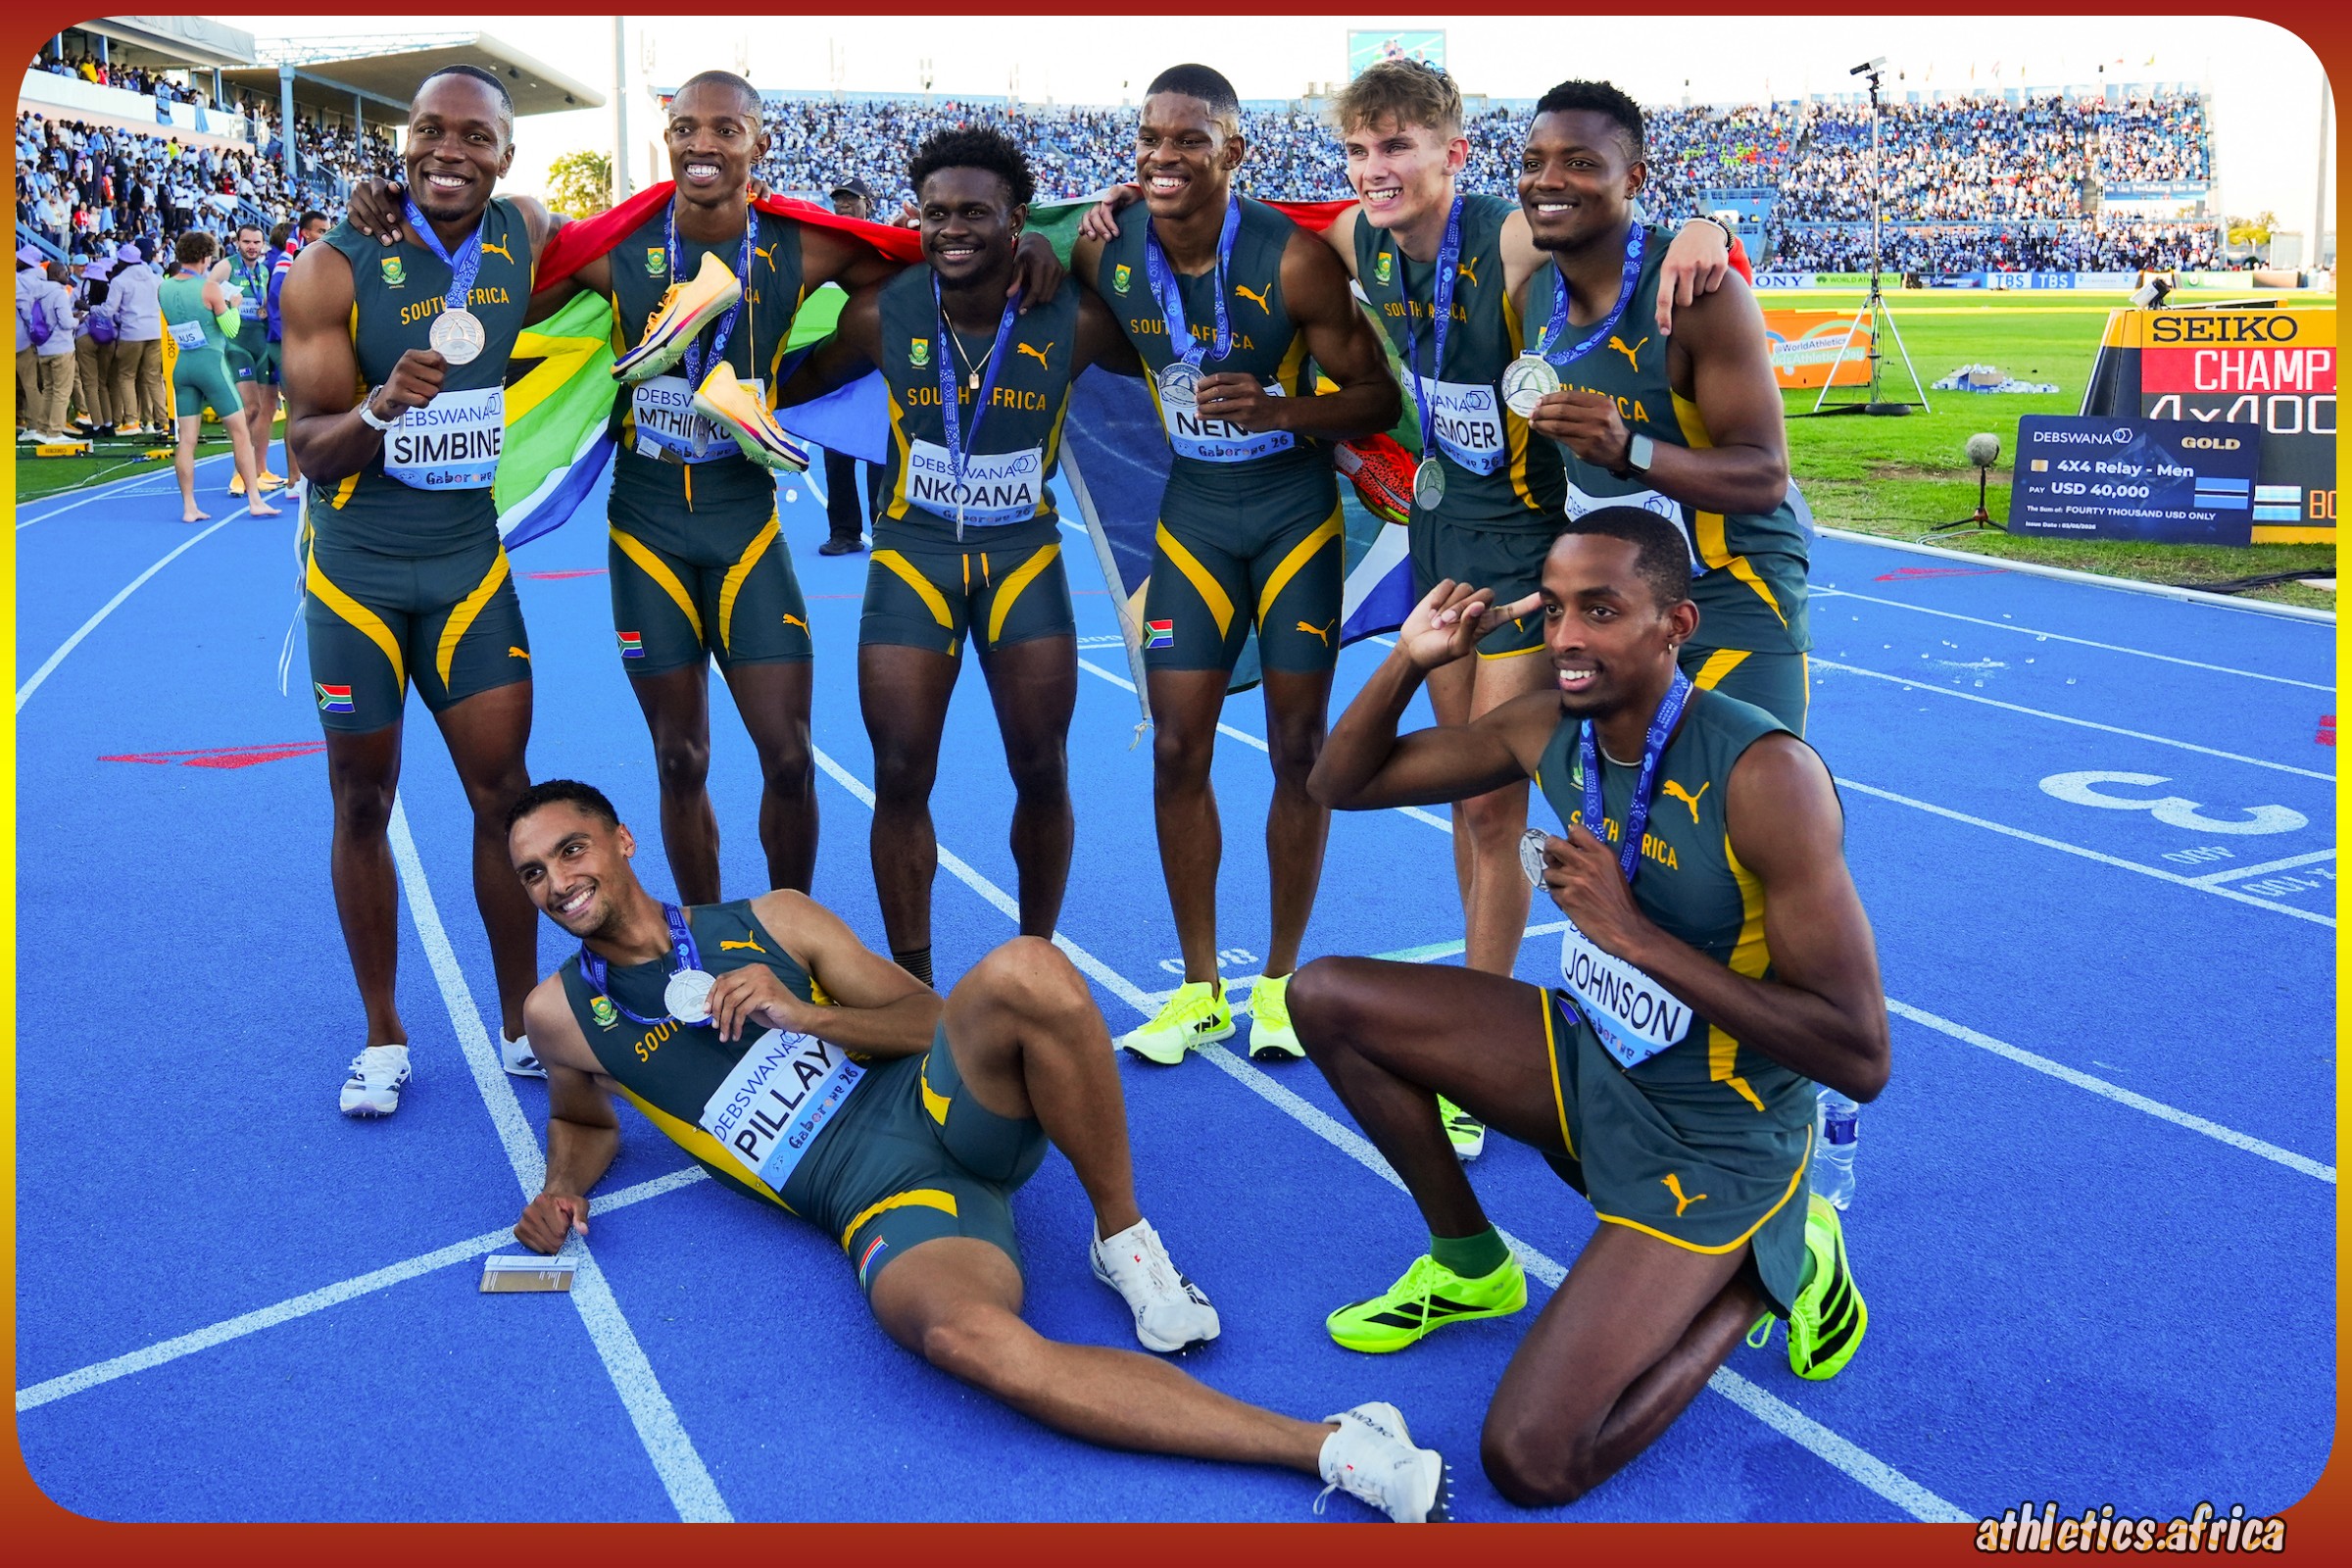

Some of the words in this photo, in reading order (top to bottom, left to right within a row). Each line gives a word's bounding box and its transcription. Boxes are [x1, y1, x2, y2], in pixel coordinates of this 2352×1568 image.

[1755, 275, 1803, 287] ONY
[1995, 274, 2024, 288] TBS
[2038, 274, 2069, 288] TBS
[466, 287, 510, 307] FRICA
[178, 333, 196, 343] AUS
[1130, 318, 1170, 336] SOUT
[1192, 324, 1254, 350] AFCA
[2152, 316, 2298, 342] SEIKO
[907, 385, 970, 407] SOUH
[987, 386, 1047, 412] FRICA
[1176, 412, 1254, 438] NEN
[1434, 414, 1497, 450] EMOER
[394, 427, 501, 465] SIMBINE
[1271, 435, 1289, 449] 26
[2034, 431, 2113, 446] DEBSWANA
[2180, 436, 2241, 451] GOLD
[1481, 456, 1499, 470] 26
[2057, 460, 2091, 472] 4X4
[2095, 461, 2143, 477] Relay
[2157, 464, 2194, 477] Men
[912, 475, 1032, 508] NKOANA
[2051, 482, 2086, 495] USD
[2090, 484, 2150, 499] 40,000
[1015, 508, 1030, 518] 26
[2065, 506, 2105, 515] FOURTY
[2107, 508, 2163, 518] THOUSAND
[2165, 511, 2187, 520] USD
[2188, 512, 2217, 521] ONLY
[2038, 770, 2309, 835] 3
[1568, 809, 1619, 842] STH
[1642, 833, 1679, 870] RICA
[1159, 948, 1259, 974] 80
[1565, 948, 1681, 1042] JOHNSON
[635, 1013, 686, 1062] SOUT
[839, 1066, 859, 1086] 26
[713, 1042, 798, 1142] DEBSWANA
[734, 1039, 831, 1162] PILLAY
